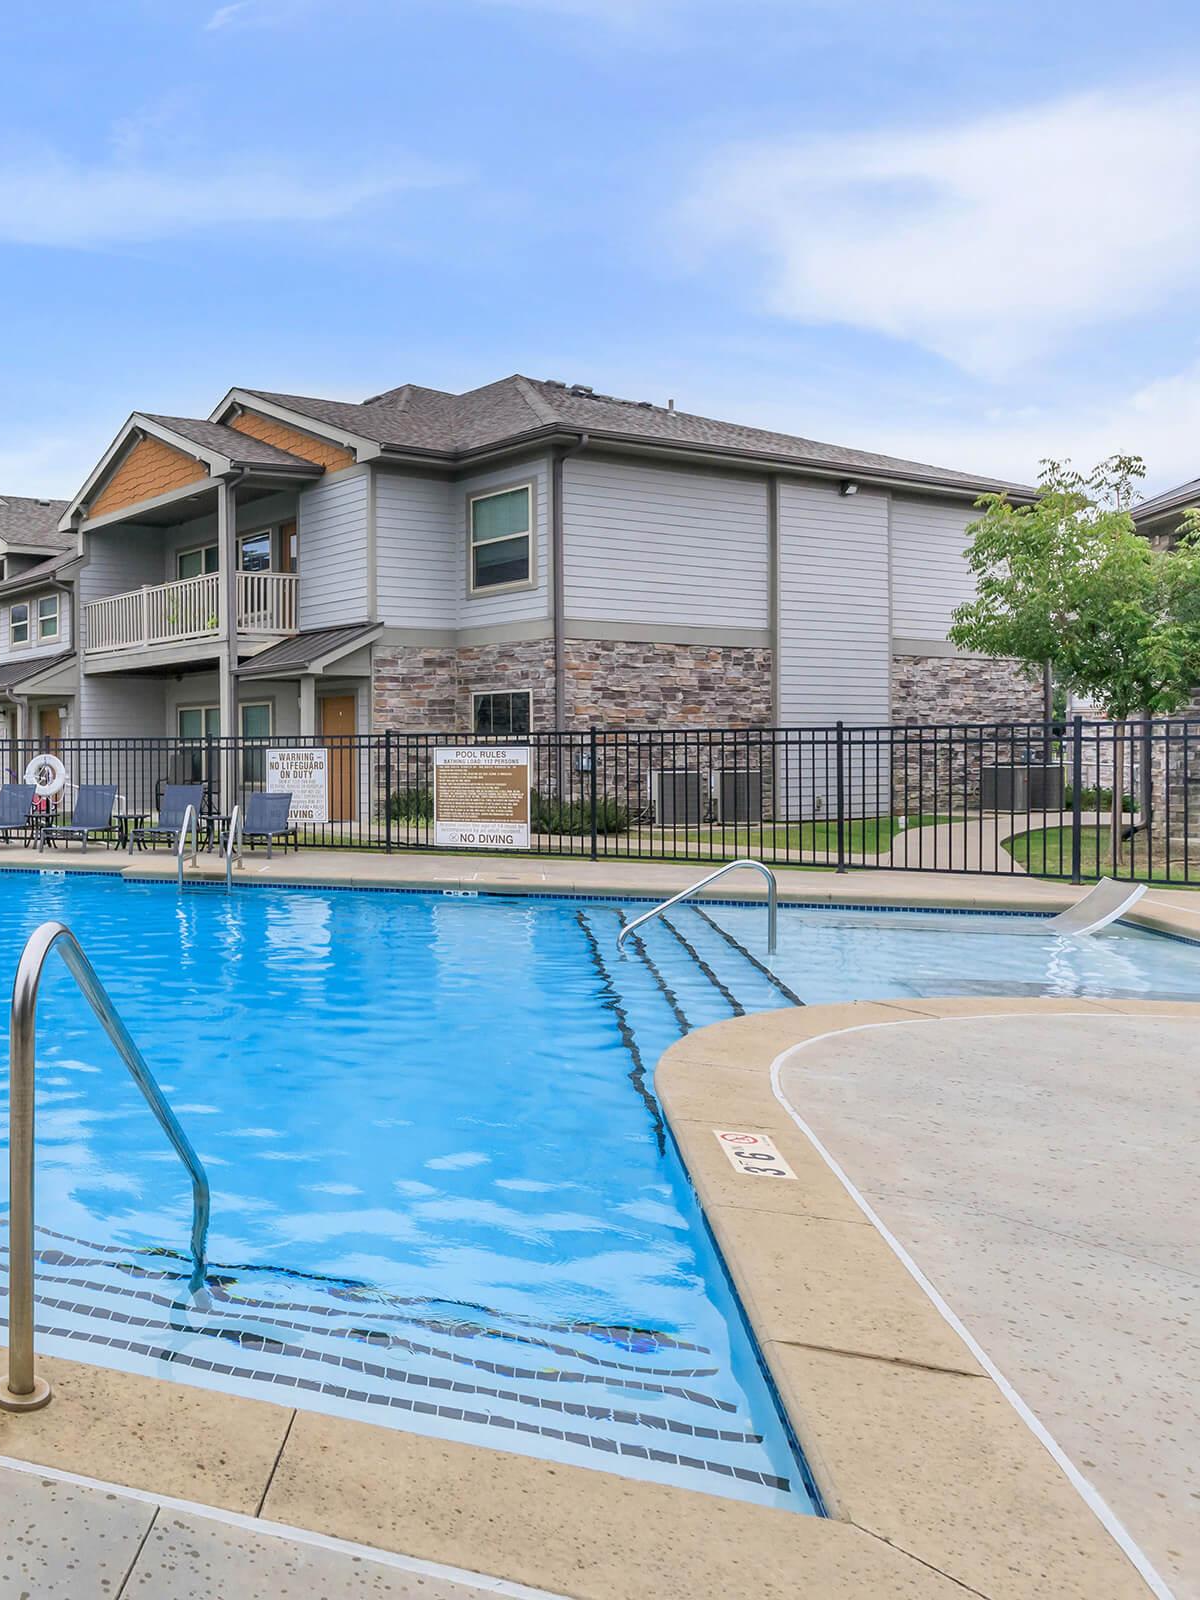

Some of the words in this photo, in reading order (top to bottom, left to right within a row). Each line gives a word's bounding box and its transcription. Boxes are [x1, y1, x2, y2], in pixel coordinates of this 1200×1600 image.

[279, 753, 314, 761] WARNING
[480, 751, 507, 759] RULES
[270, 761, 280, 770] NO
[282, 761, 324, 770] LIFEGUARD
[280, 770, 290, 779] ON
[293, 770, 313, 779] DUTY
[289, 810, 314, 818] IVING
[460, 833, 475, 843] NO
[479, 834, 514, 844] DIVING
[734, 1151, 776, 1161] 6
[743, 1166, 786, 1176] 3
